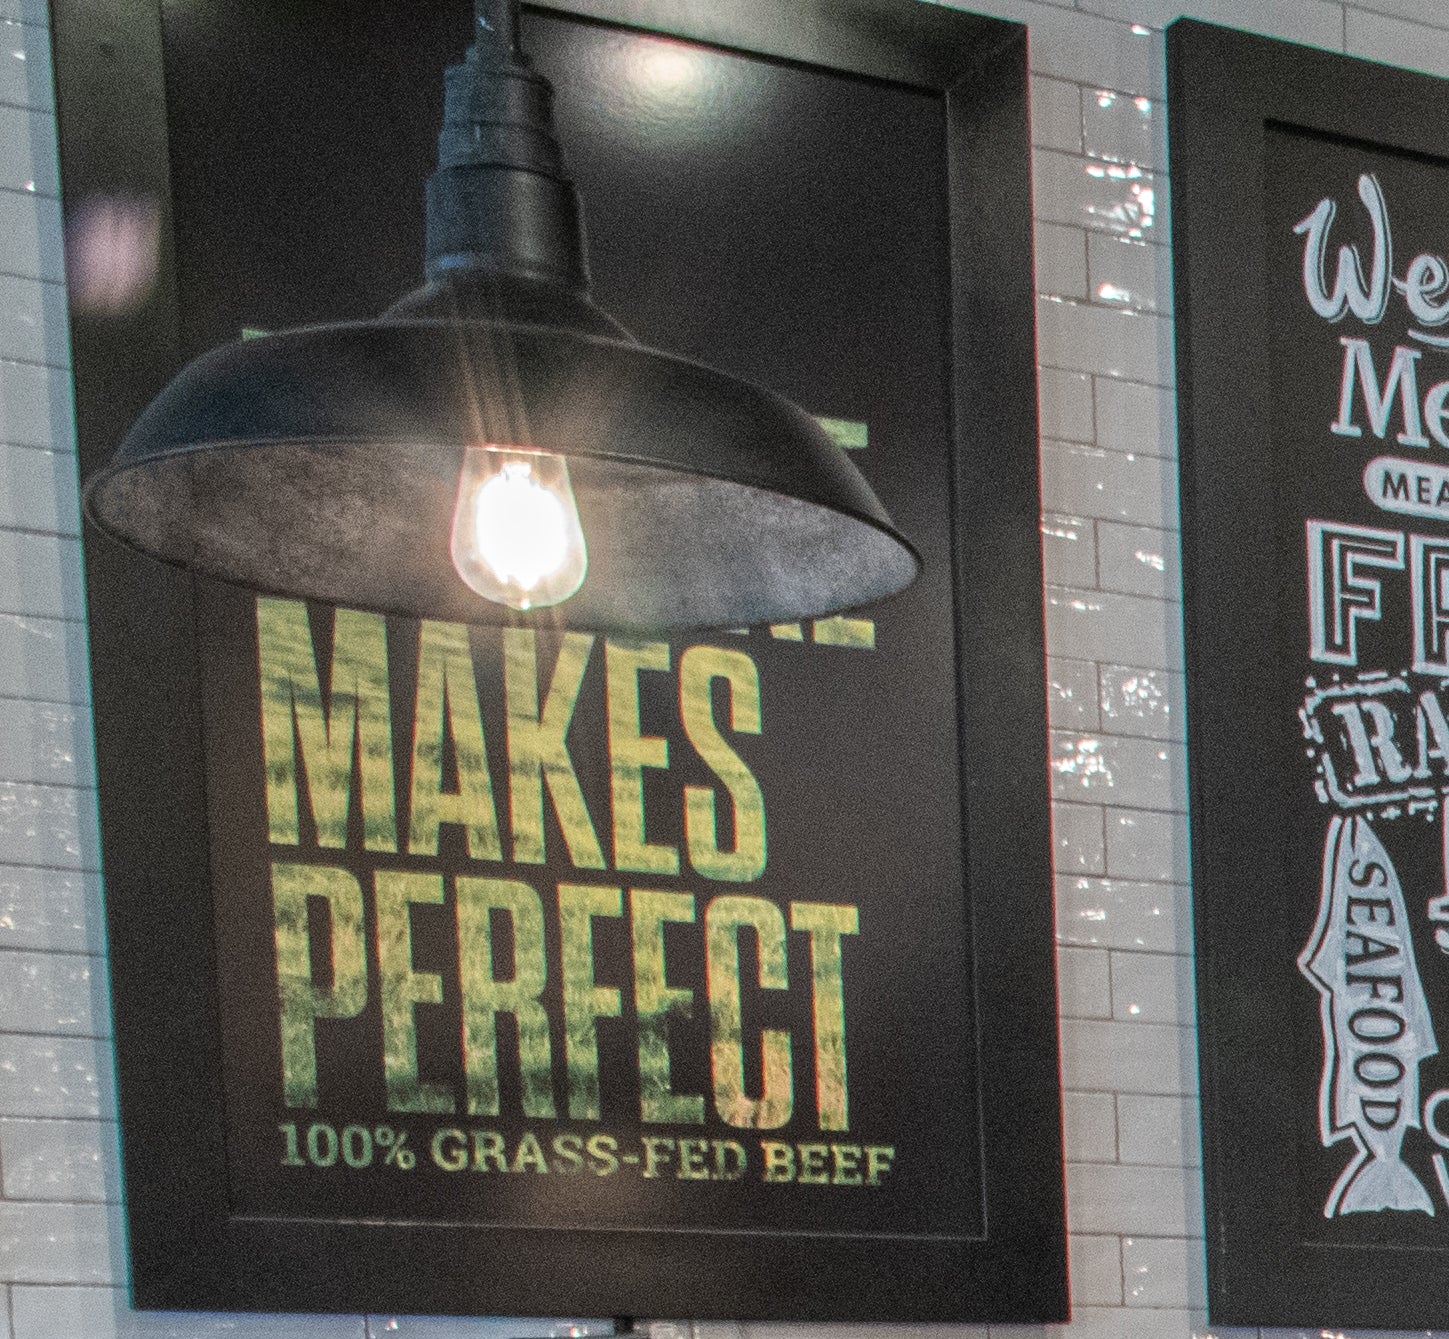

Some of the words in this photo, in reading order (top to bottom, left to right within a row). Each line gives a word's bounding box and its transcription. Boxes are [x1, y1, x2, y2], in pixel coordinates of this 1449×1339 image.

[256, 597, 768, 883] MAKES
[269, 862, 860, 1133] PERFECT
[1344, 858, 1407, 1132] SEAFOOD
[279, 1122, 417, 1173] 100%
[430, 1127, 749, 1182] GRASS-FED
[762, 1140, 896, 1187] BEEF
